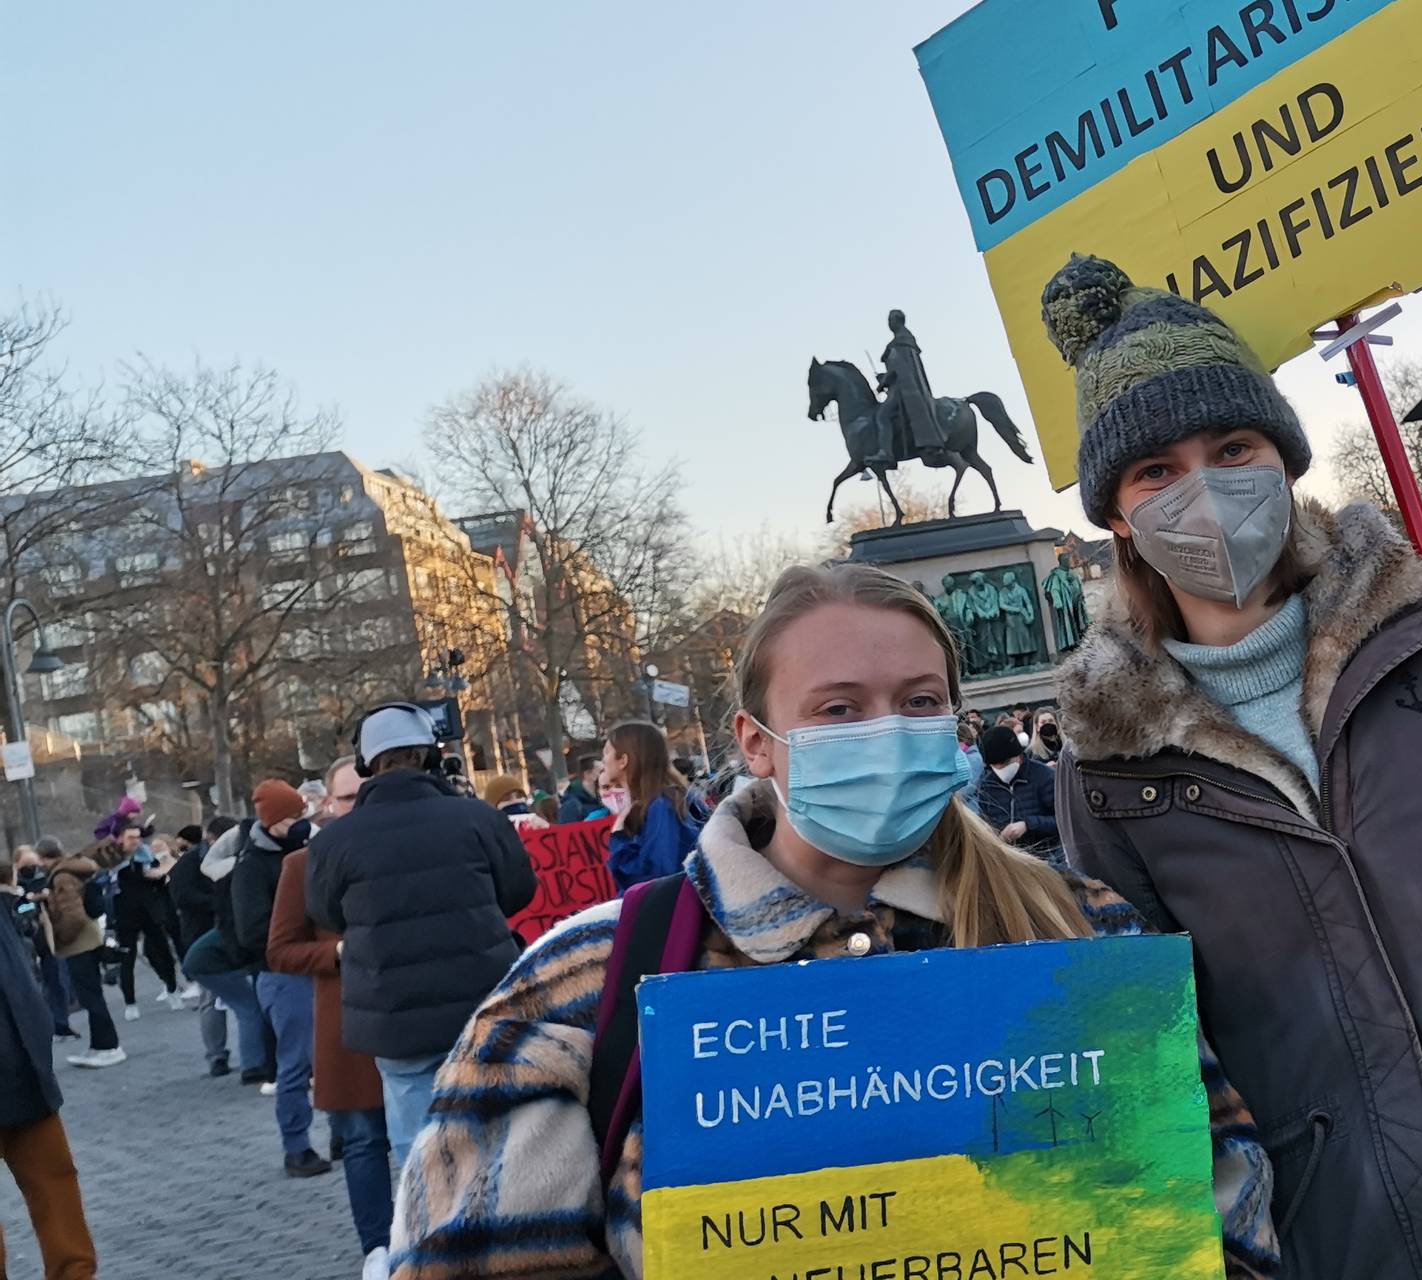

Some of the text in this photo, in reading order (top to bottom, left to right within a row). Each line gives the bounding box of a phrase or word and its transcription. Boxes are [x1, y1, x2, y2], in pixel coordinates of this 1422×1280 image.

[1206, 82, 1344, 194] UND
[692, 1009, 849, 1059] ECHTE
[695, 1048, 1105, 1128] UNABHÄNGIGKEIT
[701, 1190, 897, 1250] NUR MIT
[769, 1231, 1093, 1280] ERBAREN
